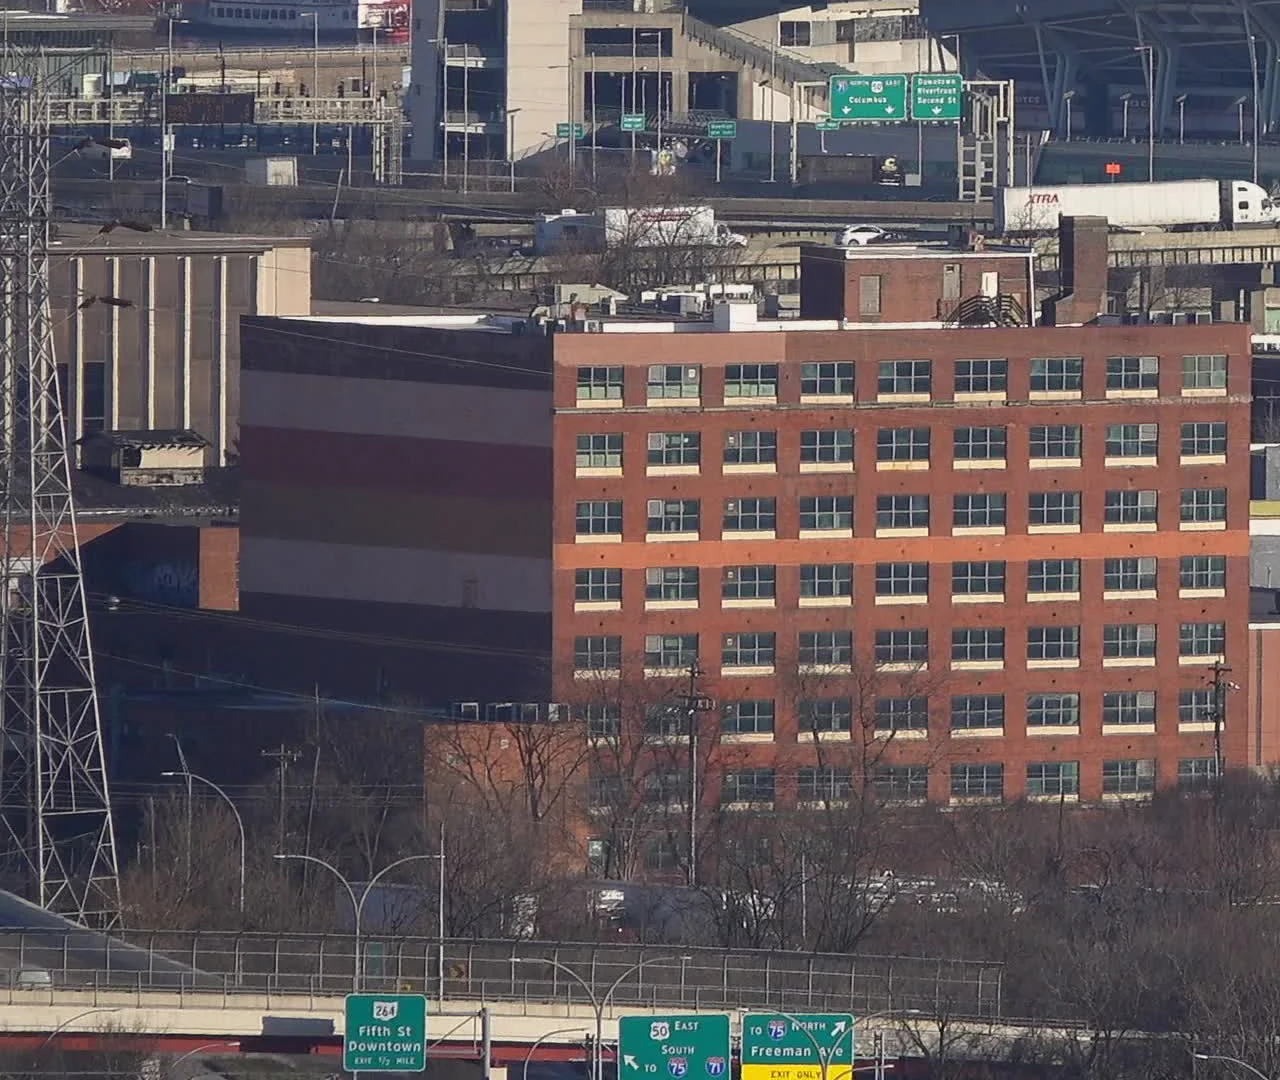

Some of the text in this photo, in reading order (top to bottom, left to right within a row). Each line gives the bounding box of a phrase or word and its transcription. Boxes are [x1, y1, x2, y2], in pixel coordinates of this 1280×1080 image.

[1029, 193, 1059, 204] XTRA
[376, 1006, 396, 1017] 264
[359, 1025, 411, 1037] Fifth St
[652, 1021, 699, 1038] 50 EAST
[751, 1022, 826, 1038] TO 75 NORTH
[349, 1041, 421, 1052] Downtown
[661, 1045, 695, 1055] SOUTH
[751, 1046, 811, 1057] Freeman
[354, 1057, 372, 1065] EXIT
[396, 1057, 416, 1065] MILE
[644, 1062, 721, 1074] TO 75 71
[770, 1071, 821, 1079] EXIT ONLY
